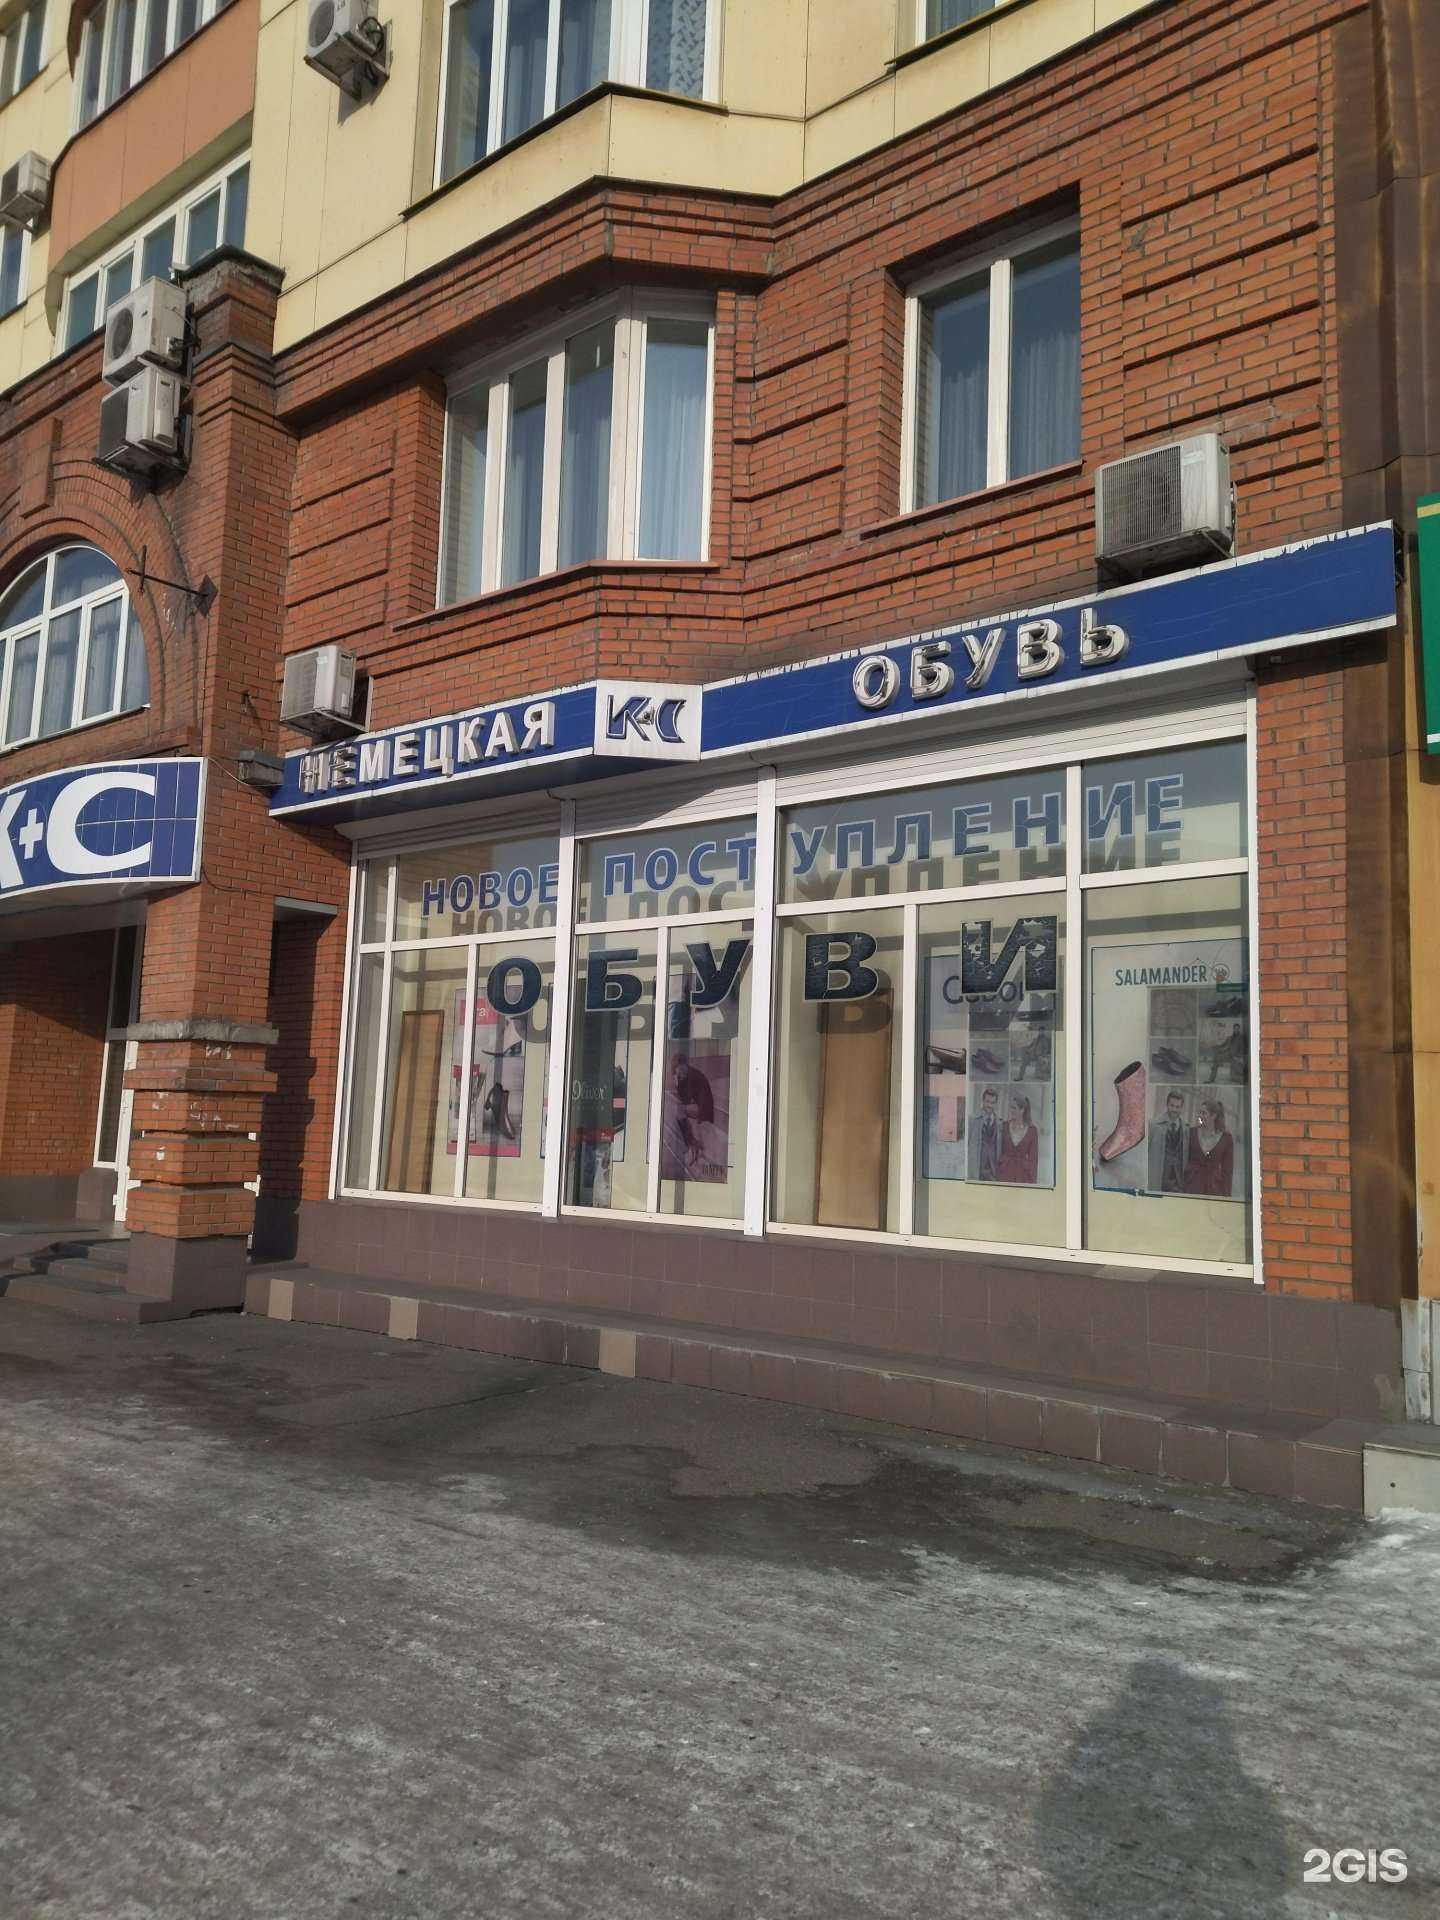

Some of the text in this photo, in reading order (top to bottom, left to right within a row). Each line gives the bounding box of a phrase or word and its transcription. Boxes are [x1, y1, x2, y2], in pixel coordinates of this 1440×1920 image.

[299, 701, 556, 794] НЕМЕЦКАЯ
[852, 607, 1130, 710] ОБУВЬ
[422, 863, 560, 918] НОВОЕ
[487, 915, 1060, 1017] ОБУВИ
[1115, 965, 1208, 987] SALAMANDER
